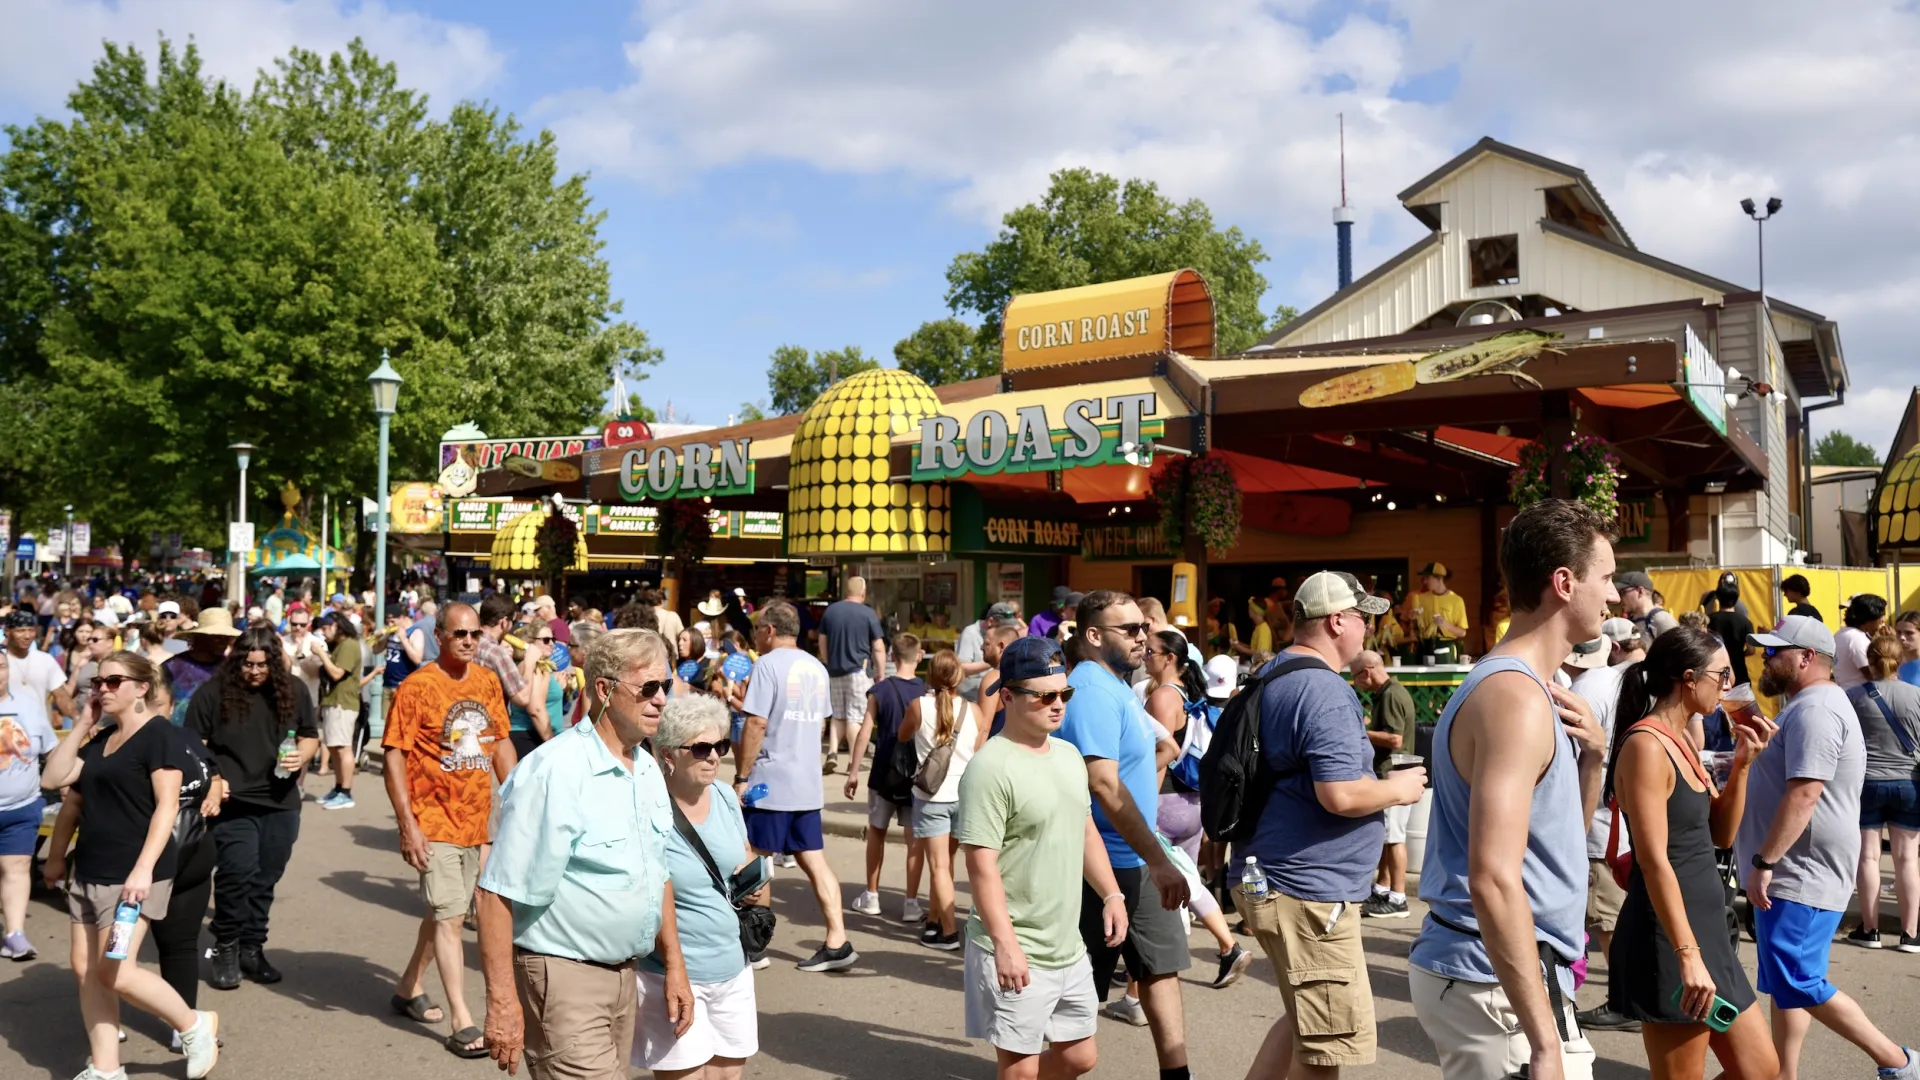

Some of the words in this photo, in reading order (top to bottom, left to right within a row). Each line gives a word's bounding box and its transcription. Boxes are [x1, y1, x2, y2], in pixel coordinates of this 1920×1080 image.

[1017, 320, 1075, 352] CORN
[1080, 308, 1150, 343] ROAST
[479, 440, 585, 467] ITALIAN
[619, 436, 753, 495] CORN
[916, 392, 1157, 470] ROAST
[986, 516, 1029, 544] CORN
[1033, 520, 1079, 546] ROAST
[1083, 526, 1131, 557] SWEET
[386, 648, 401, 663] 32
